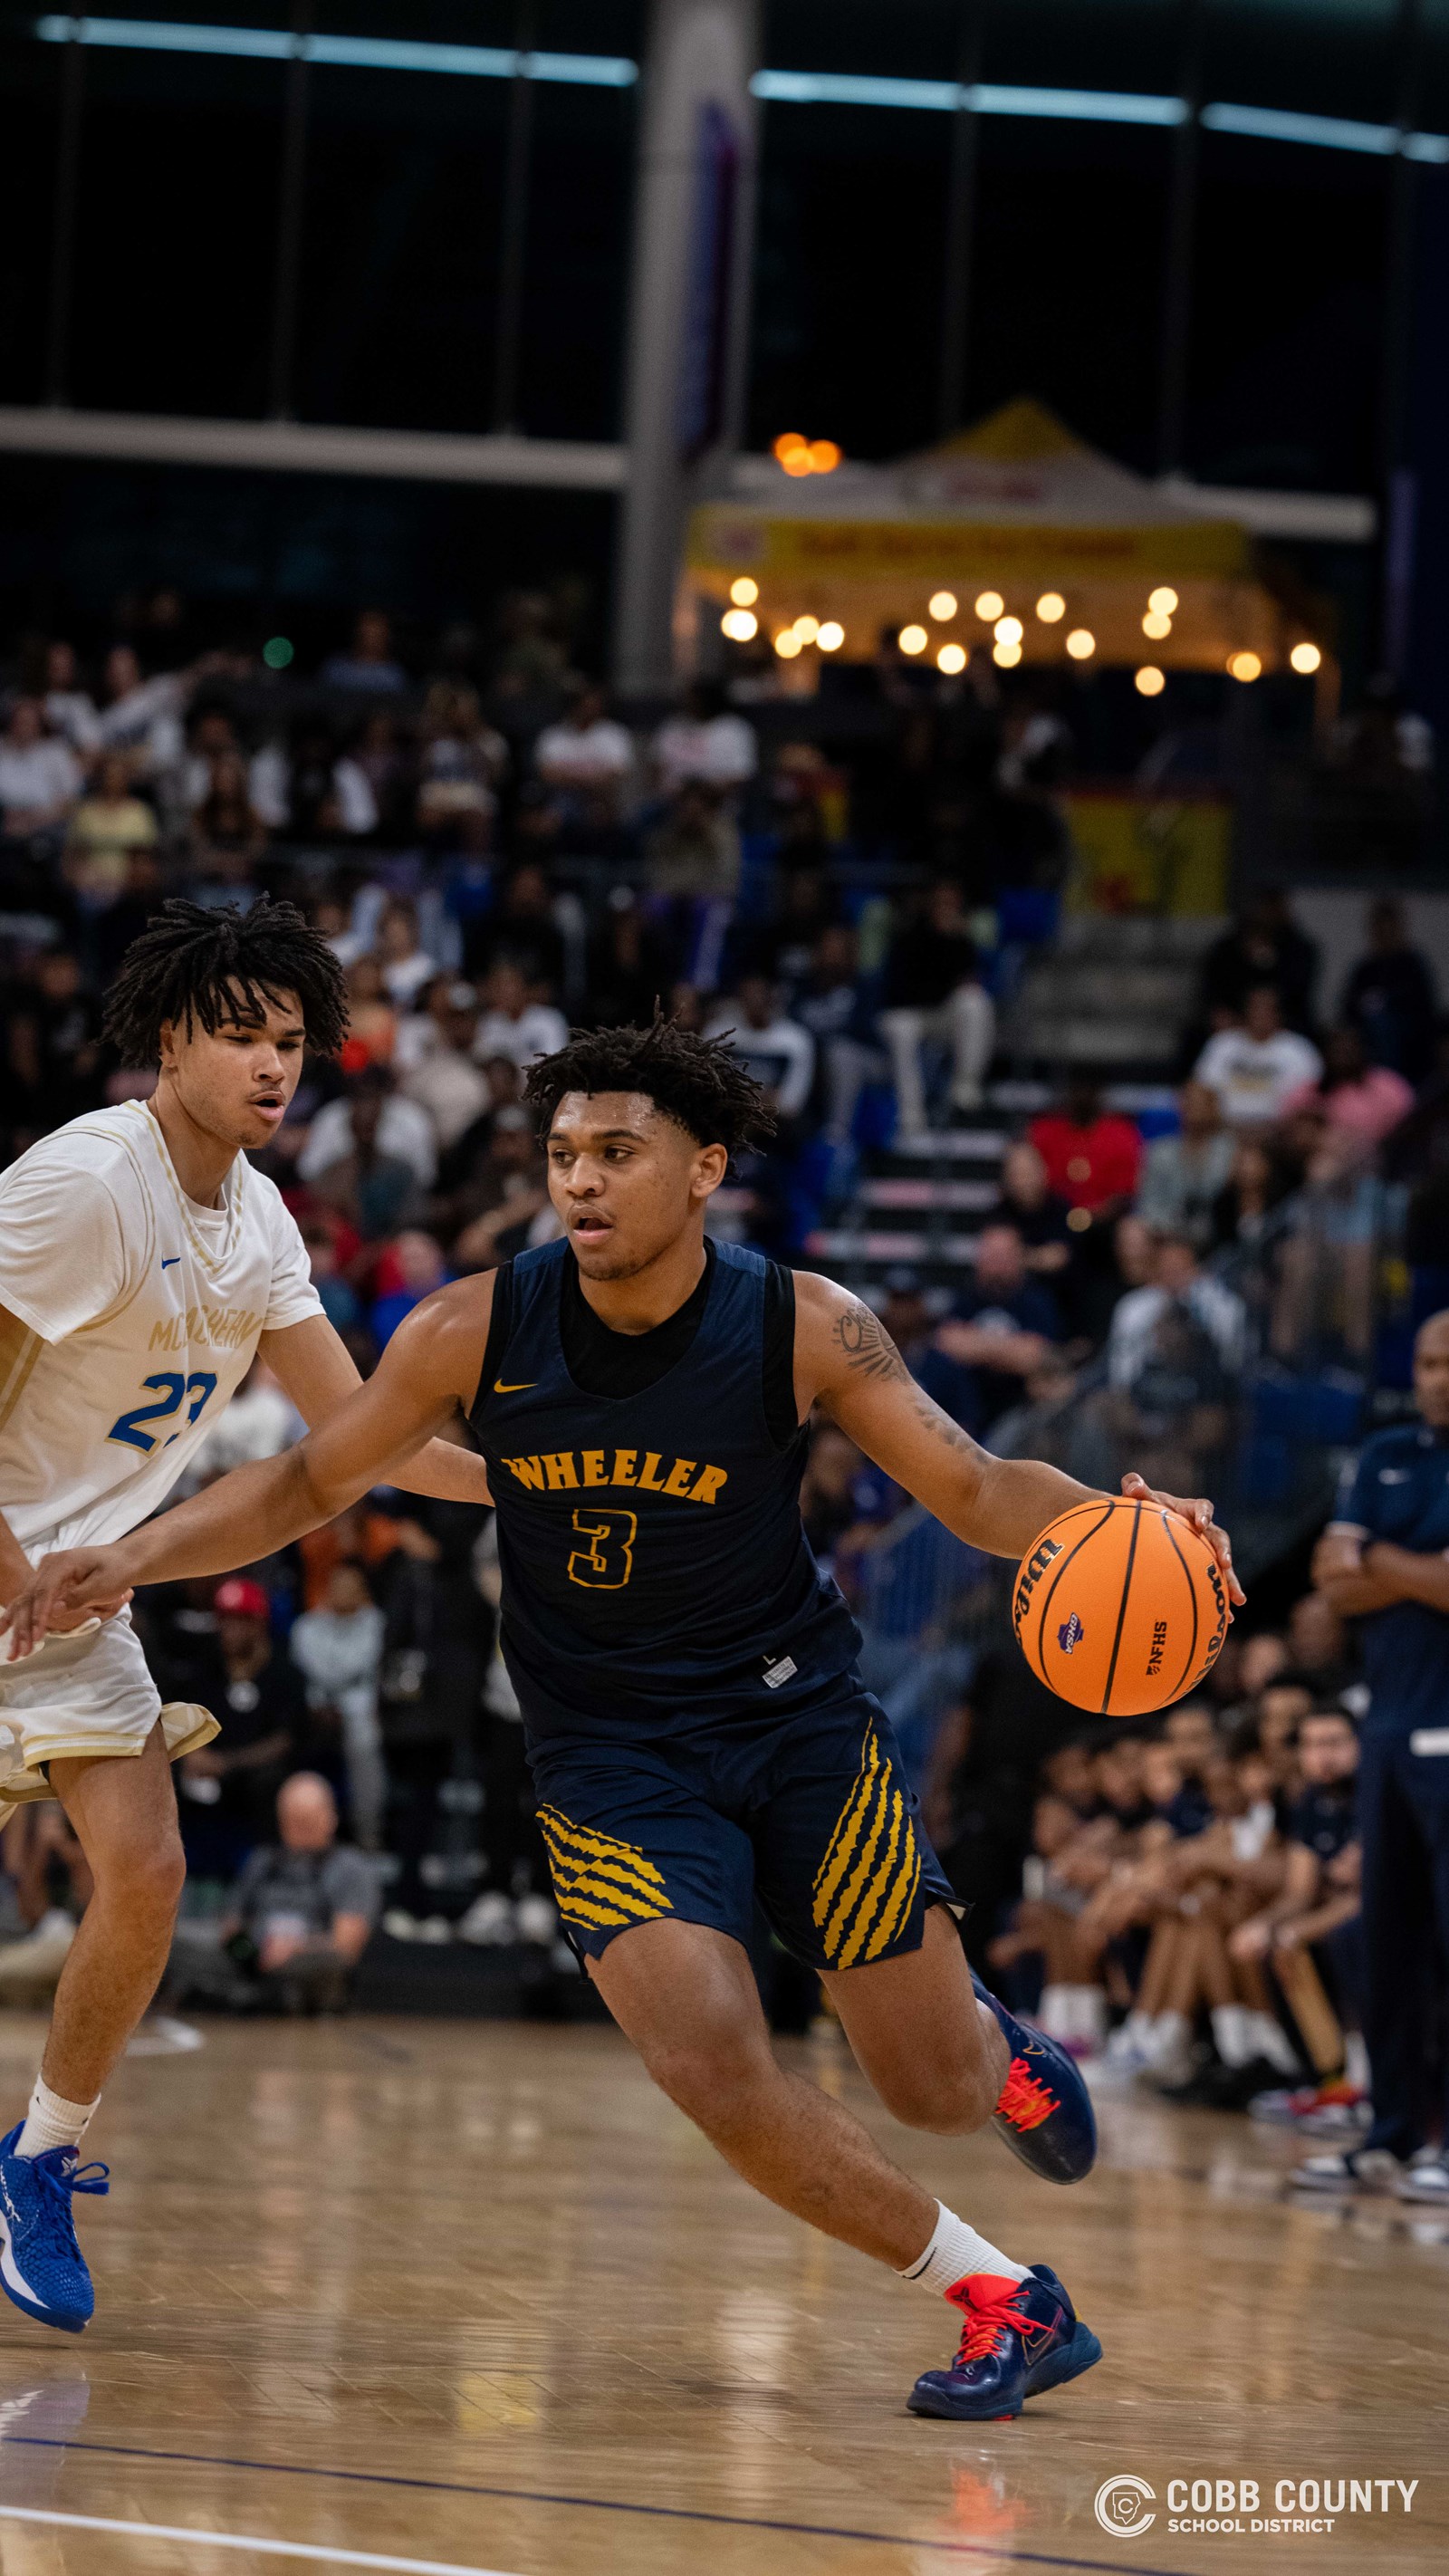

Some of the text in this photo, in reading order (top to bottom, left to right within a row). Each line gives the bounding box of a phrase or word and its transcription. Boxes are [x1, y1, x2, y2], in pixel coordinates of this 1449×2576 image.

[148, 1304, 264, 1351] MCACHERN
[501, 1449, 728, 1504] WHEELER
[567, 1508, 638, 1590] 3
[1065, 1612, 1080, 1655] GHSA
[1148, 1620, 1167, 1665] NFHS
